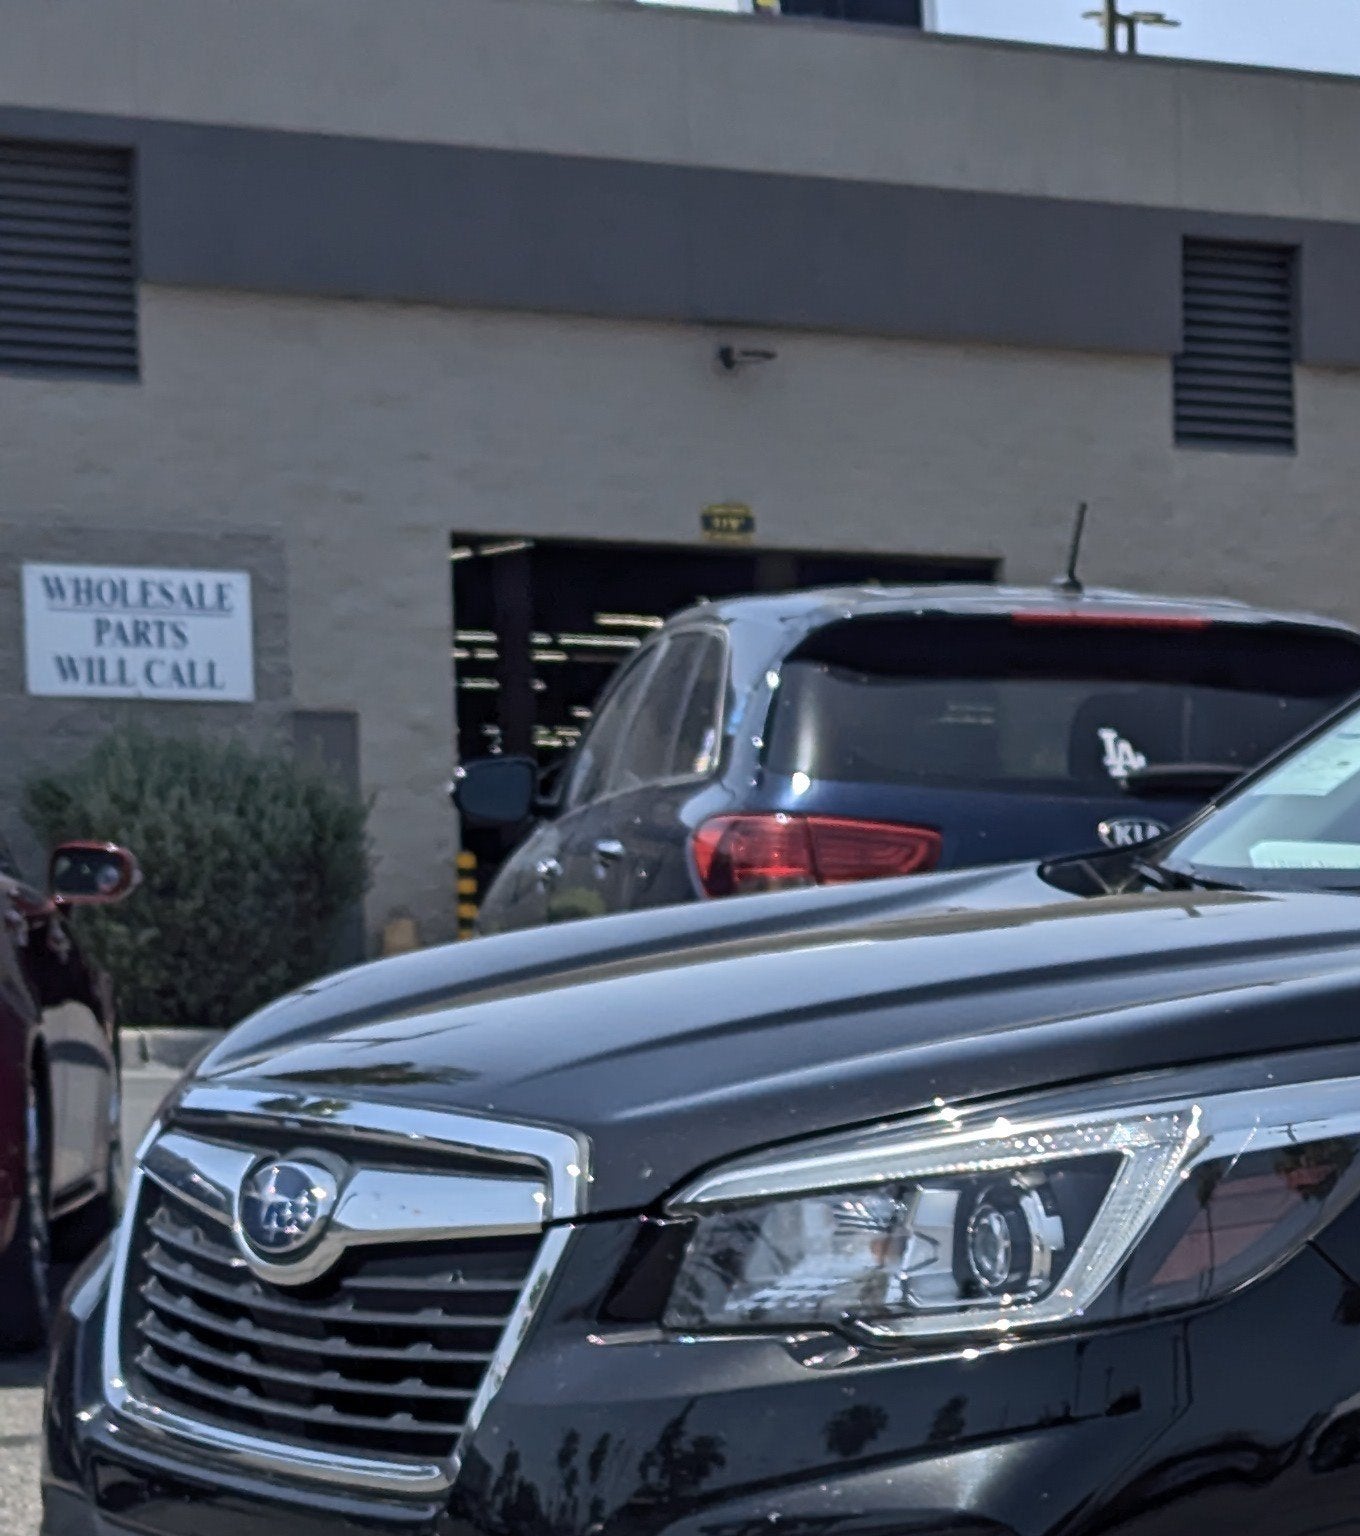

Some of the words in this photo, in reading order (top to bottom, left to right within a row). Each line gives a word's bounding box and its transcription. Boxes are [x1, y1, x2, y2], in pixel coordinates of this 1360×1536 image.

[41, 574, 233, 612] WHOLESALE
[94, 617, 189, 649] PARTS
[55, 654, 134, 686] WILL
[143, 658, 225, 690] CALL
[1097, 728, 1146, 777] LA
